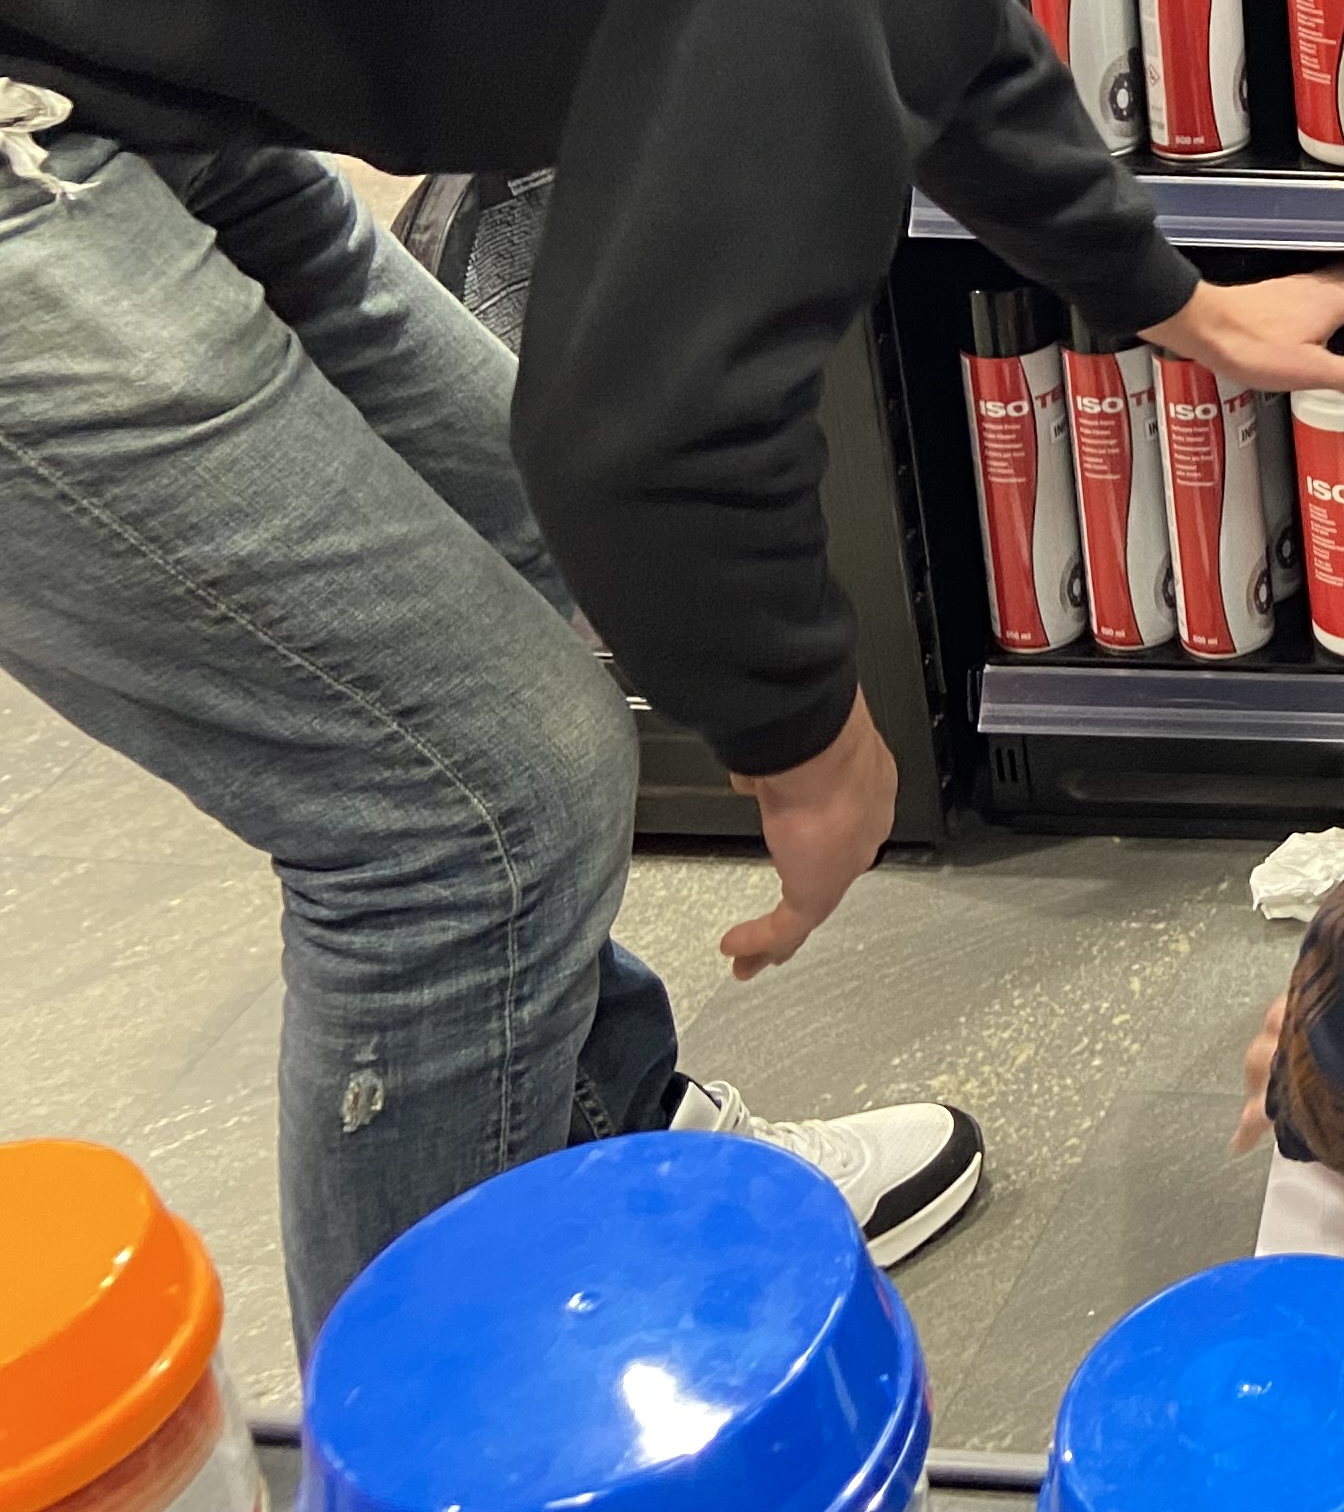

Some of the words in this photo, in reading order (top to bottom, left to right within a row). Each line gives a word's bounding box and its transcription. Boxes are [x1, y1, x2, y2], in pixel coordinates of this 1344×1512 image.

[979, 398, 1030, 418] ISO
[1076, 395, 1124, 415] ISO
[1169, 401, 1218, 421] ISO
[1223, 388, 1254, 414] TE
